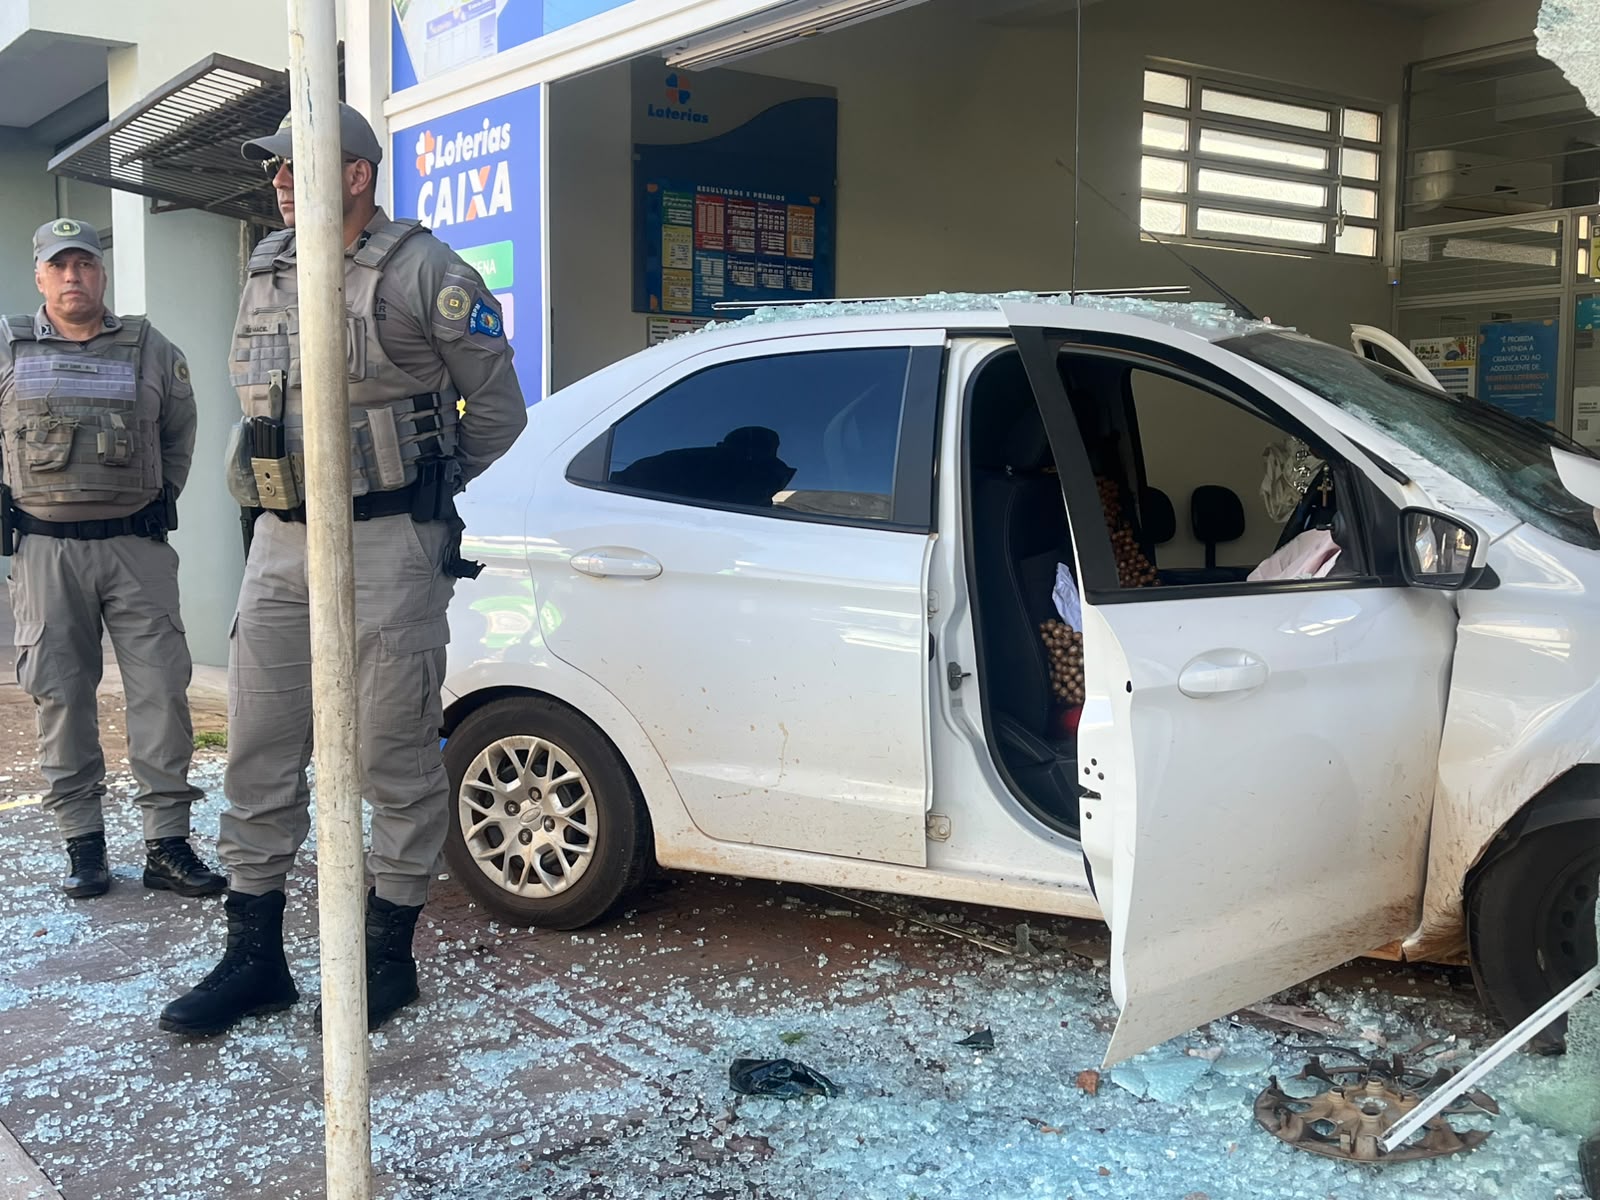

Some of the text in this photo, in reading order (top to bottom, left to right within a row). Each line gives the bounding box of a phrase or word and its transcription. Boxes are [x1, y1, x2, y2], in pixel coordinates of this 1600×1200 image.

[648, 103, 709, 124] Loterias
[434, 117, 511, 169] Loterias
[417, 160, 513, 230] CAIXA
[696, 185, 744, 197] RESULTADOS
[1531, 353, 1542, 361] AO
[1490, 364, 1531, 372] ADOLESCENTE
